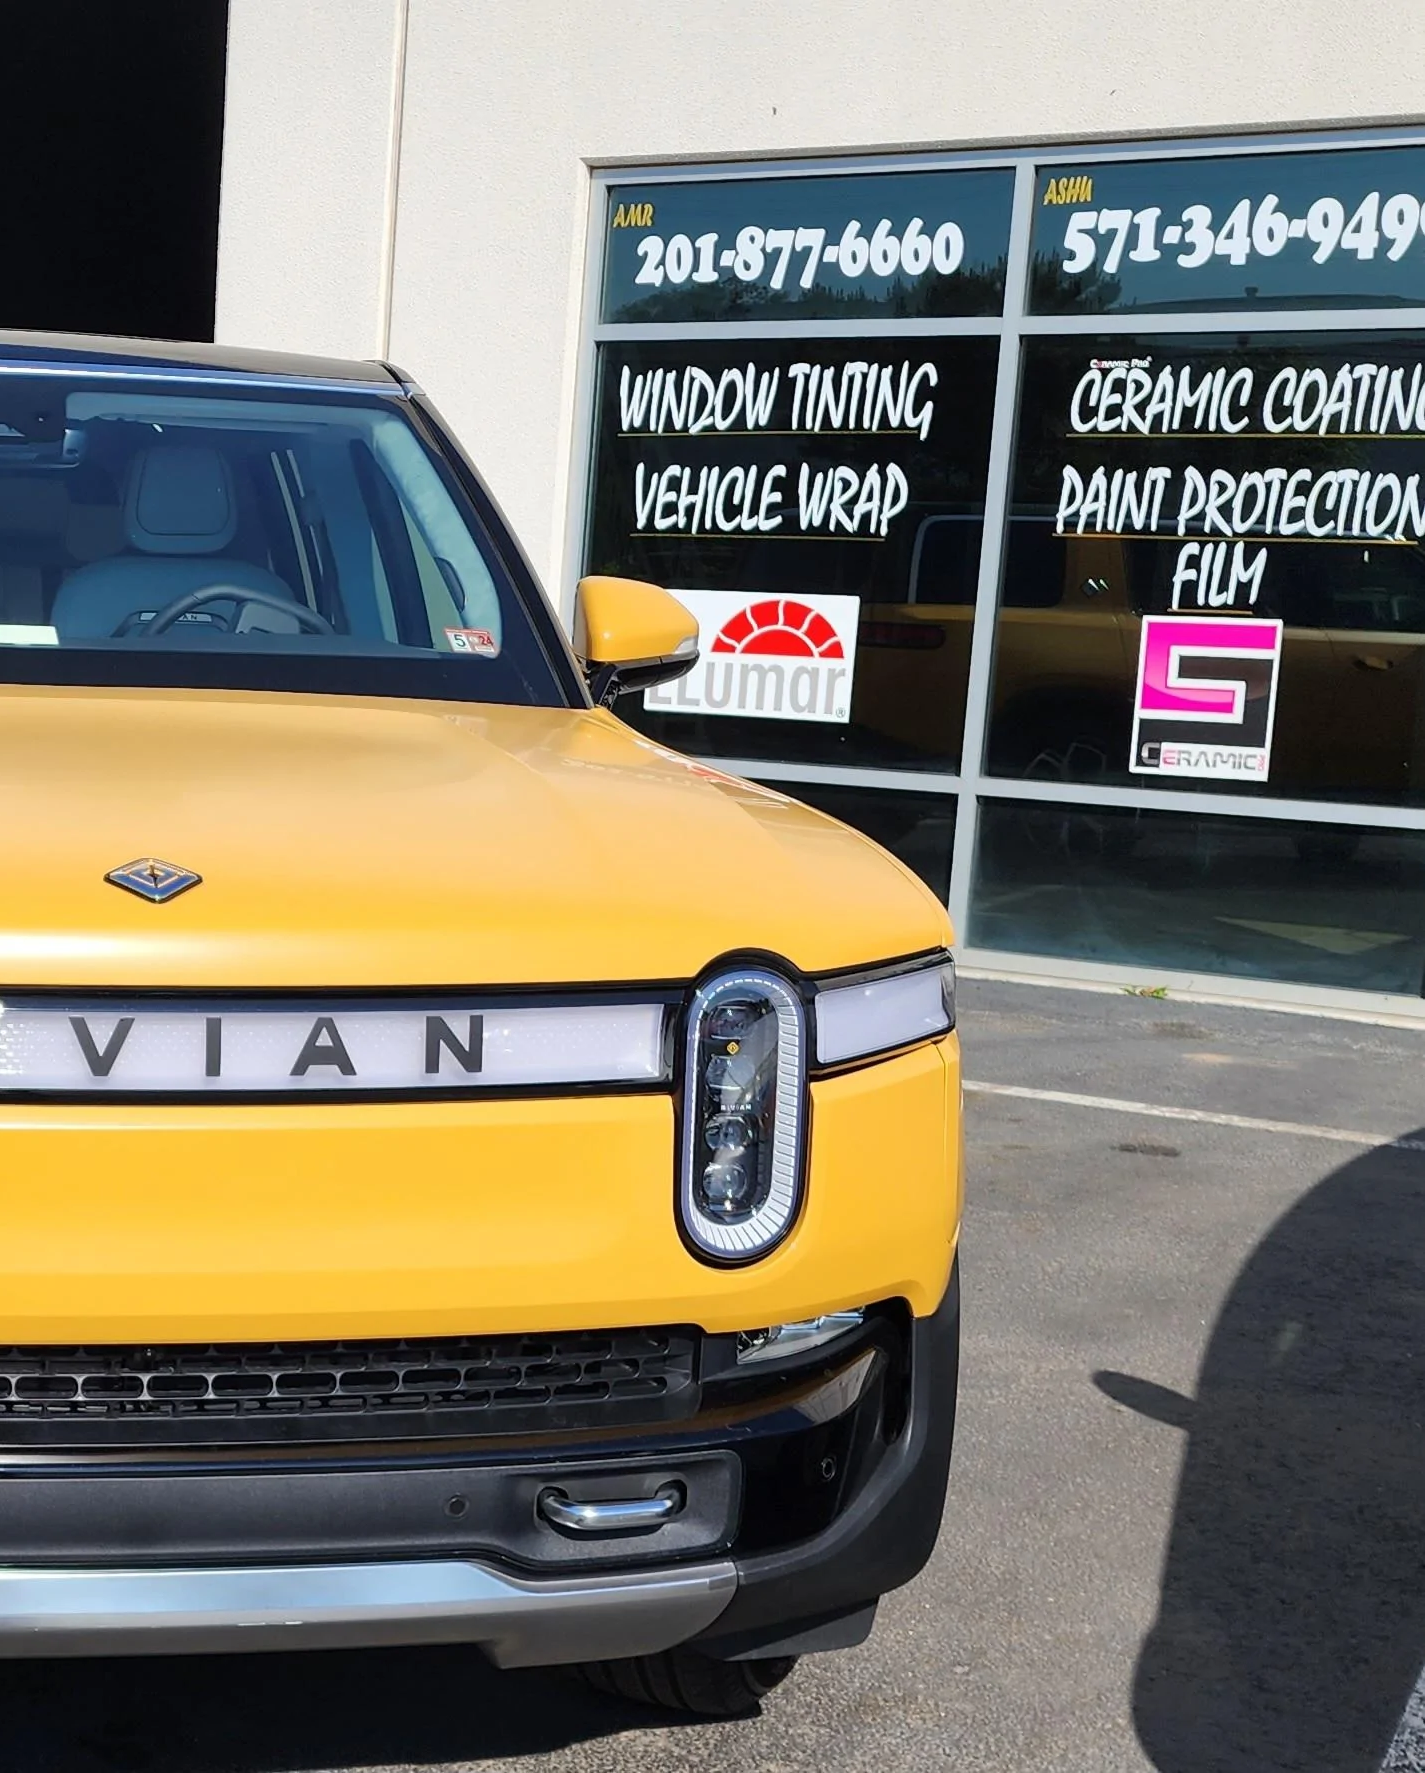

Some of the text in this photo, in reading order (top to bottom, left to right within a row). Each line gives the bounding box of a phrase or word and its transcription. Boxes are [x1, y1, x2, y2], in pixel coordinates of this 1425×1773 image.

[613, 203, 654, 228] AMR
[1062, 191, 1425, 275] 571-346-949
[634, 217, 965, 290] 201-877-6660
[619, 360, 939, 441] WINDOW TINTING
[1070, 364, 1254, 435] CERAMIC
[635, 462, 909, 537] VEHICLE WRAP
[1055, 464, 1425, 539] PAINT PROTECTION
[1171, 540, 1268, 611] FILM
[453, 633, 495, 648] 5 24
[1141, 741, 1257, 771] CERAMIC
